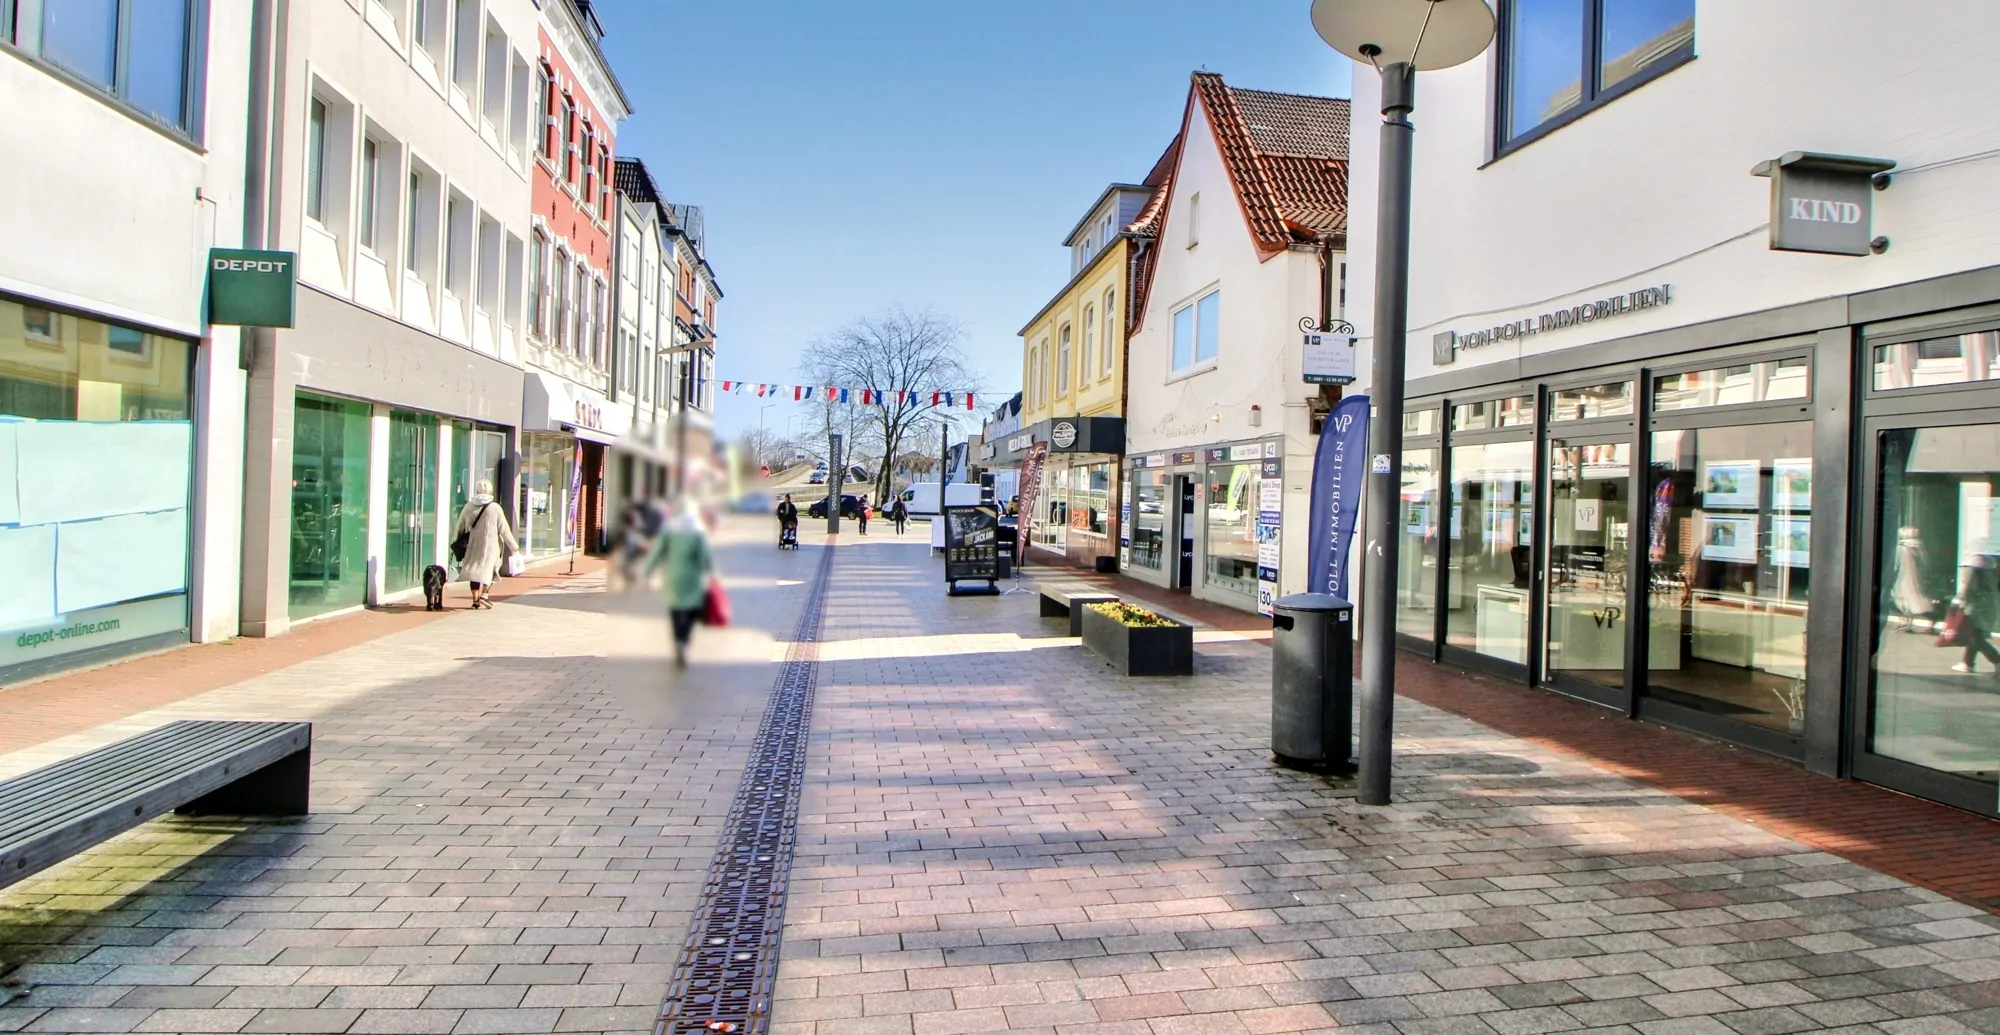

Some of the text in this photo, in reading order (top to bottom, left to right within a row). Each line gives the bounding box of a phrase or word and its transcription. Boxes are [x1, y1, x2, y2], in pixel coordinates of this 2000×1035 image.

[1789, 197, 1861, 224] KIND
[213, 258, 288, 273] DEPOT
[1458, 283, 1671, 351] VON POLL IMMOBILIEN
[1334, 414, 1353, 433] VP
[1267, 444, 1275, 456] 42
[1330, 440, 1344, 551] IMMOBILIEN
[1578, 506, 1595, 523] VP
[1593, 606, 1622, 629] VP
[17, 618, 120, 648] depot-online.com
